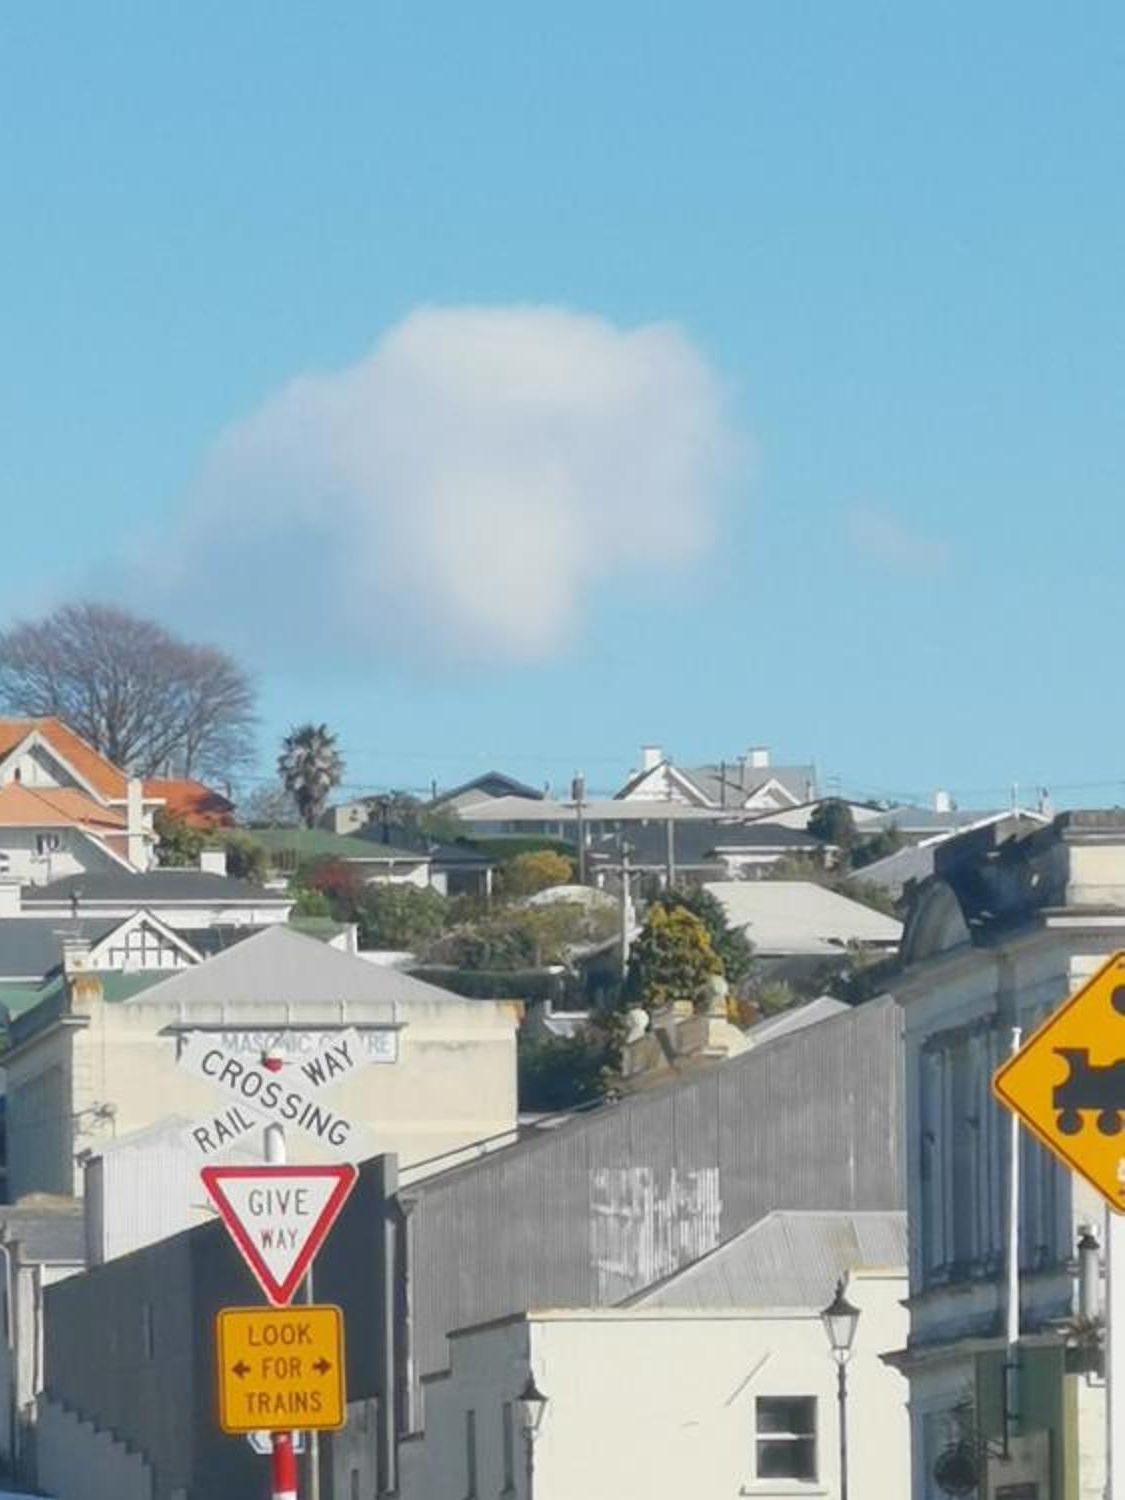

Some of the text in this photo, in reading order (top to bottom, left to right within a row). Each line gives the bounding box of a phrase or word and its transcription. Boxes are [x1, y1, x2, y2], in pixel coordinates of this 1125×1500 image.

[192, 1039, 354, 1153] RAIL WAY
[200, 1049, 351, 1147] CROSSING
[248, 1188, 309, 1216] GIVE
[260, 1227, 299, 1249] WAY
[247, 1322, 313, 1346] LOOK
[261, 1356, 302, 1379] FOR
[245, 1390, 323, 1414] TRAINS
